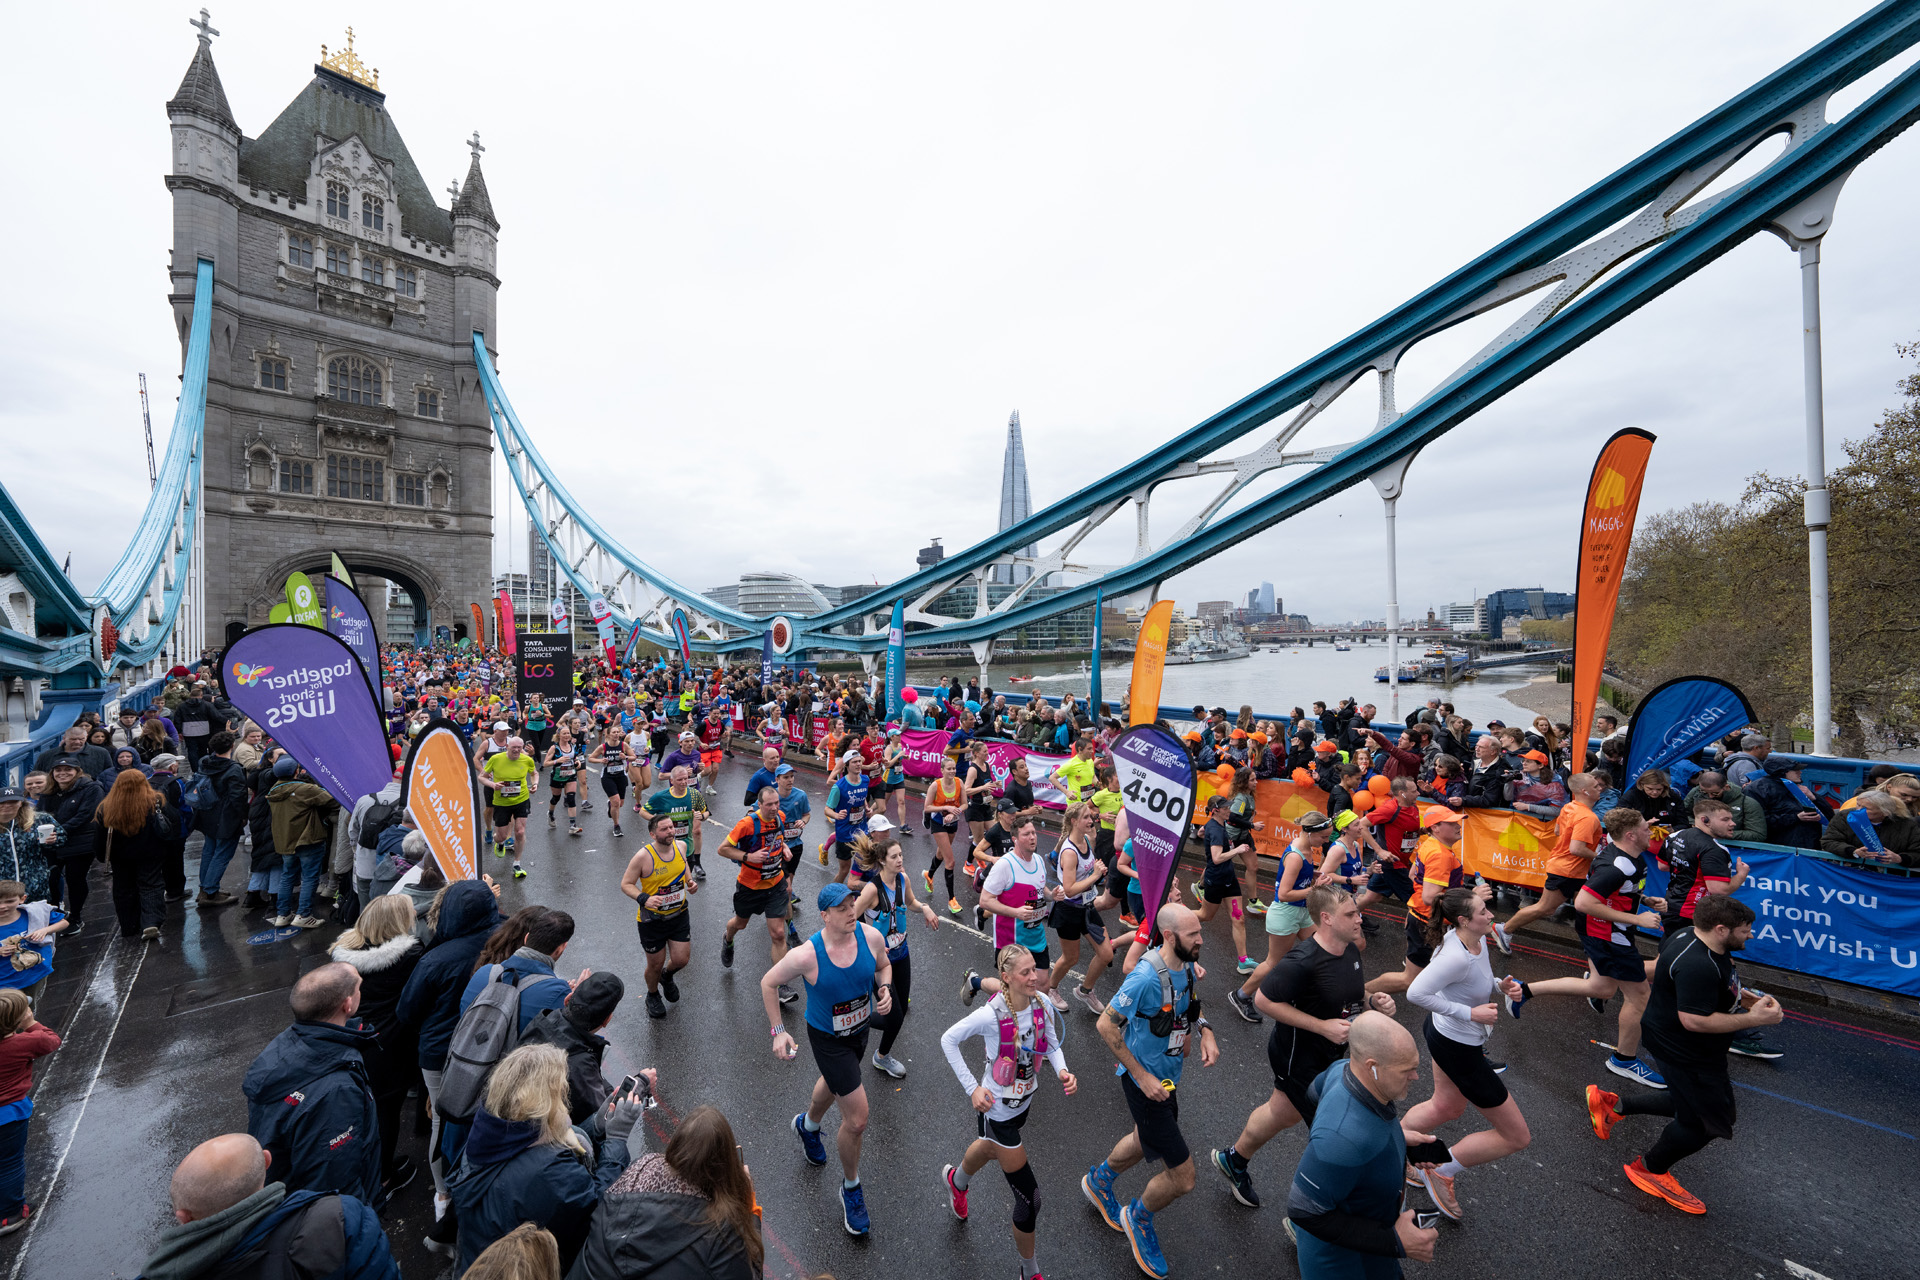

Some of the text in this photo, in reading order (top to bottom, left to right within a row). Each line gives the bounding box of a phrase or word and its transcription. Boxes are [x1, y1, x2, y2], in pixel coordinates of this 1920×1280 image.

[295, 609, 318, 624] OXFAM
[889, 650, 895, 664] UK
[524, 661, 554, 678] tcs
[763, 660, 771, 684] rust
[746, 716, 762, 730] tcs
[792, 720, 804, 739] tc
[1122, 736, 1154, 757] LME
[1154, 746, 1179, 760] LONDON
[1150, 756, 1172, 768] EVENTS
[1152, 750, 1186, 769] MARATHON
[1132, 768, 1147, 780] SUB
[1123, 778, 1185, 822] 4:00
[1135, 827, 1174, 852] INSPIRING
[1275, 826, 1301, 840] MAG
[1133, 835, 1170, 858] ACTIVITY
[1028, 888, 1045, 898] EORG
[1732, 869, 1811, 897] hank
[1818, 886, 1878, 909] you
[664, 893, 681, 904] 9938
[1760, 898, 1832, 926] from
[1750, 923, 1918, 969] -A-Wish® U
[834, 1004, 850, 1015] tcs
[840, 1008, 867, 1027] 19112
[1175, 1034, 1186, 1044] 17
[329, 1130, 350, 1146] SUPER
